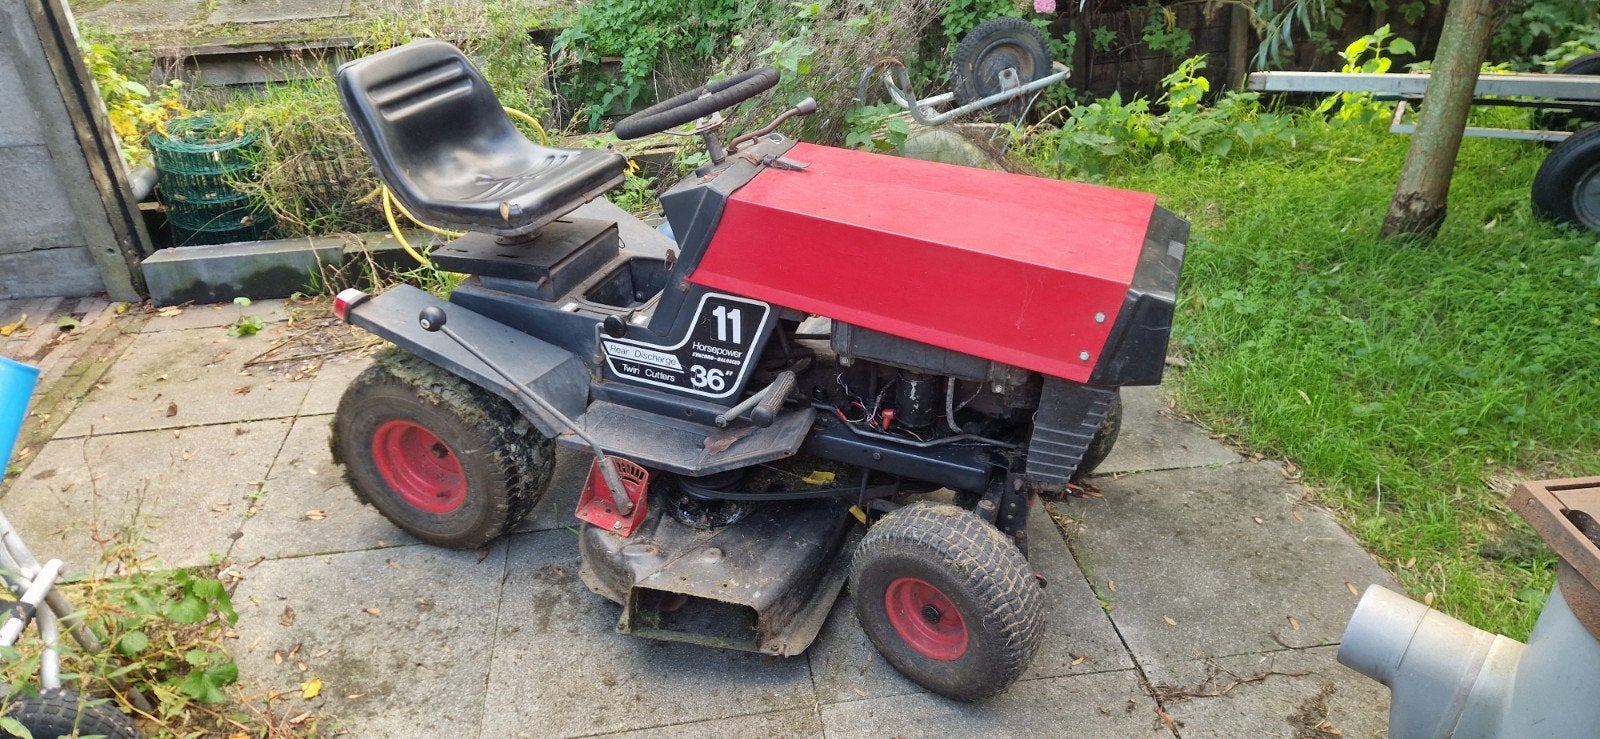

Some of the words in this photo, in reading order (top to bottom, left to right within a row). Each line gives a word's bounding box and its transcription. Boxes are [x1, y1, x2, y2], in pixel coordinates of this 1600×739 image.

[712, 305, 741, 345] 11
[610, 344, 630, 355] Rear
[634, 350, 677, 366] Discharge
[692, 341, 742, 358] Horsepower
[622, 363, 640, 375] Twin
[645, 368, 676, 382] Cutters
